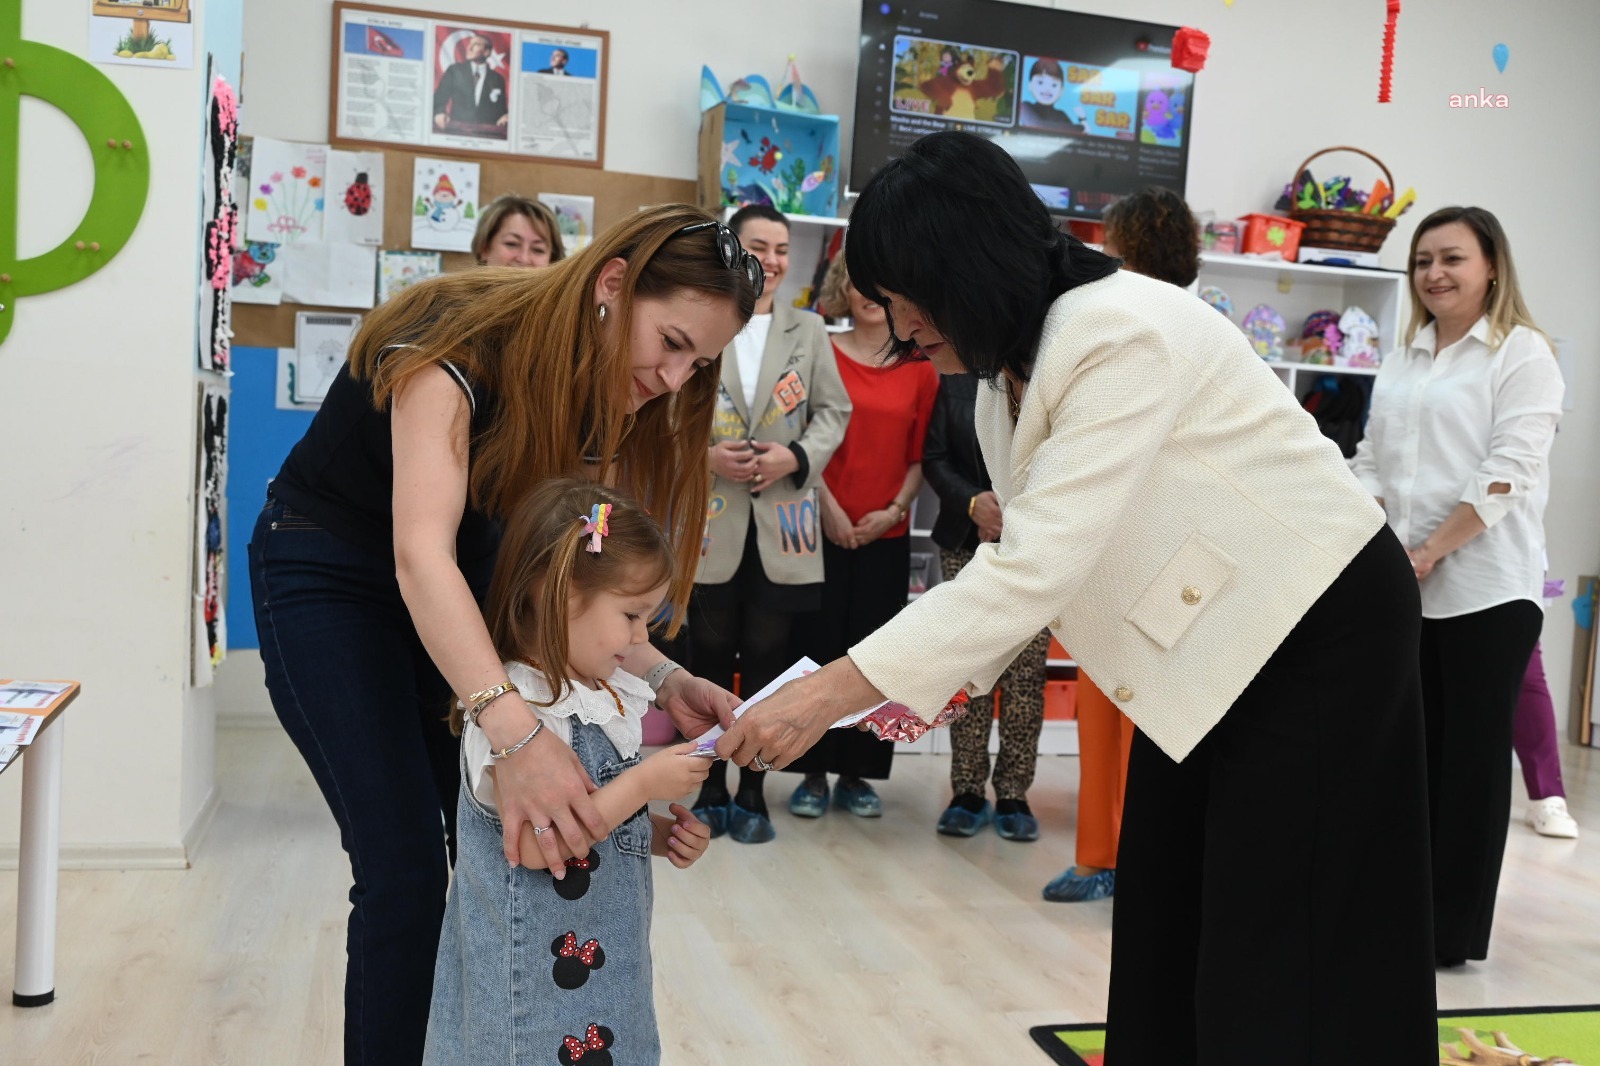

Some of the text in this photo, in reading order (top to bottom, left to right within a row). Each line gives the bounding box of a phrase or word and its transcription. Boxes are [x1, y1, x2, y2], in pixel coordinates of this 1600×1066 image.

[895, 97, 931, 113] LIVE
[1080, 89, 1116, 108] SAR
[1095, 109, 1131, 129] SAR
[776, 500, 818, 557] NO
